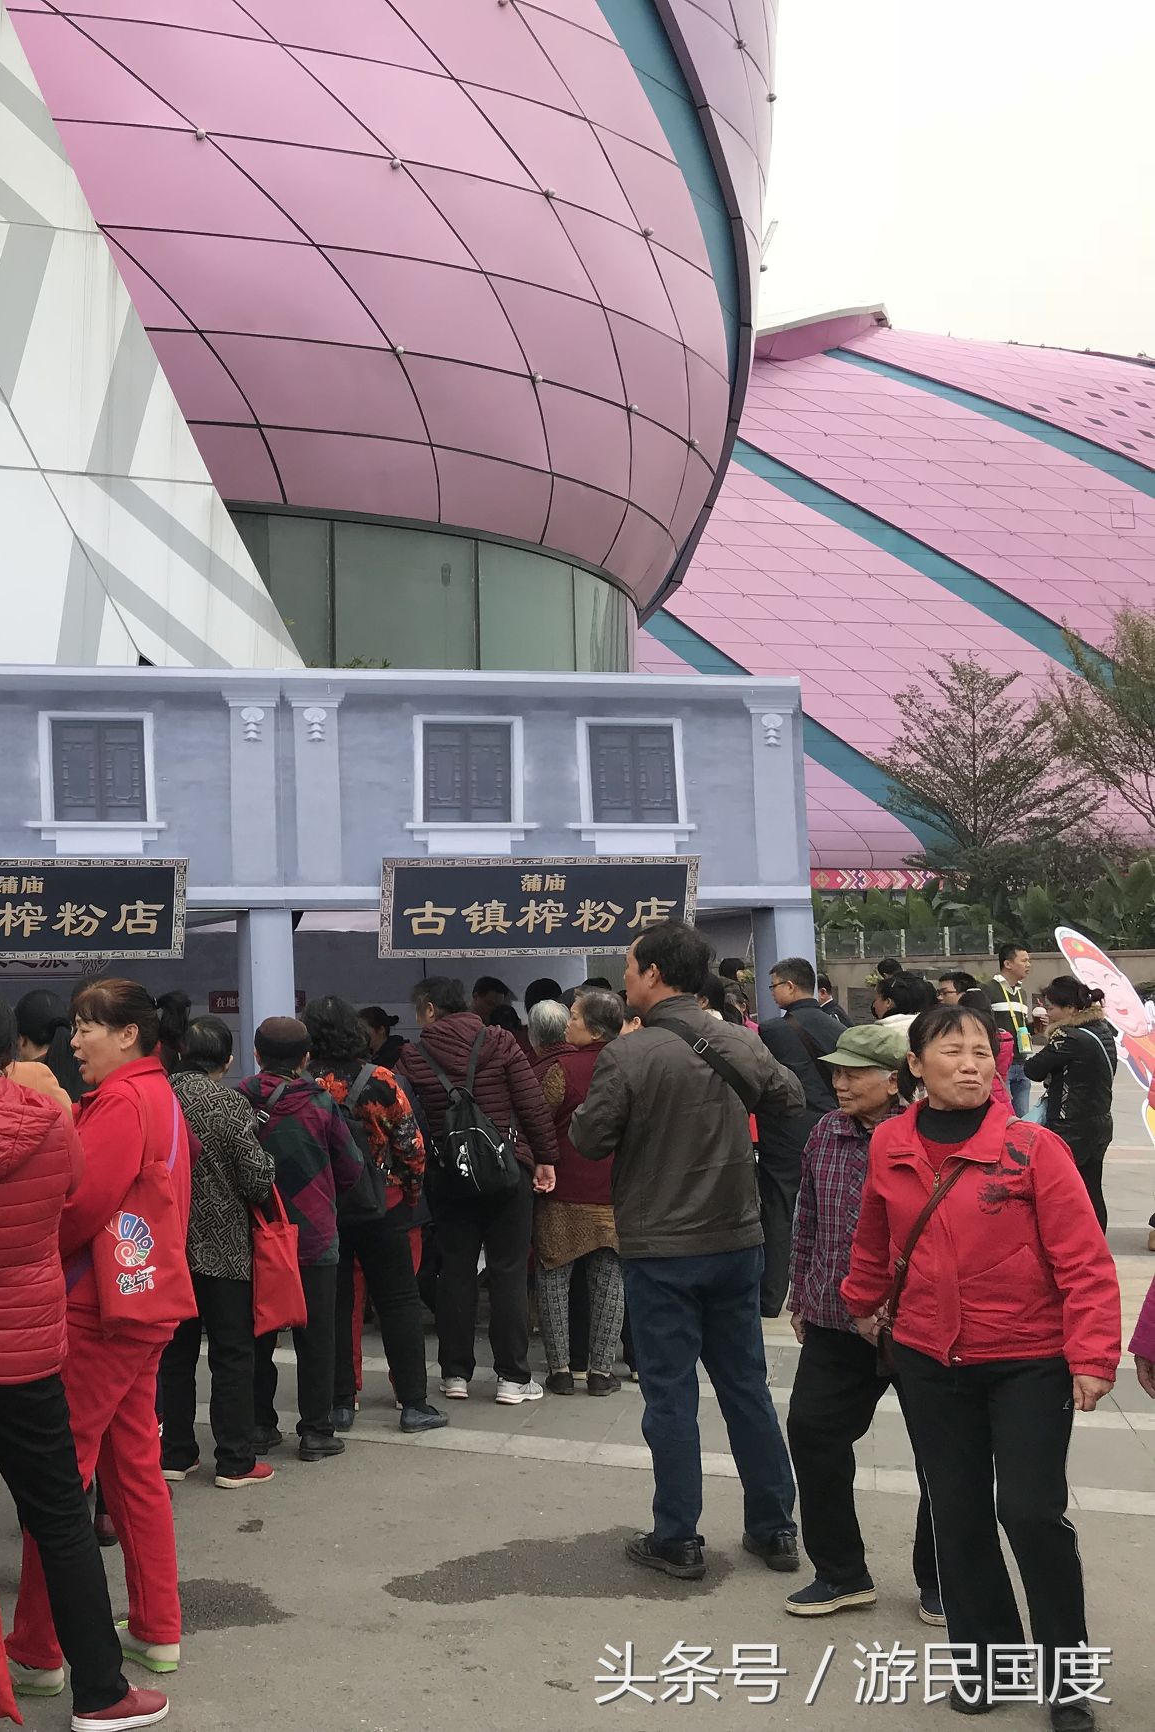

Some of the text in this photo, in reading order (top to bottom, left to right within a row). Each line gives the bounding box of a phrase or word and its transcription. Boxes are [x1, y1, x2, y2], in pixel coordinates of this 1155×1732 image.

[520, 873, 567, 893] 蒲庙
[402, 896, 678, 936] 古镇榨粉店
[216, 996, 239, 1008] 在地
